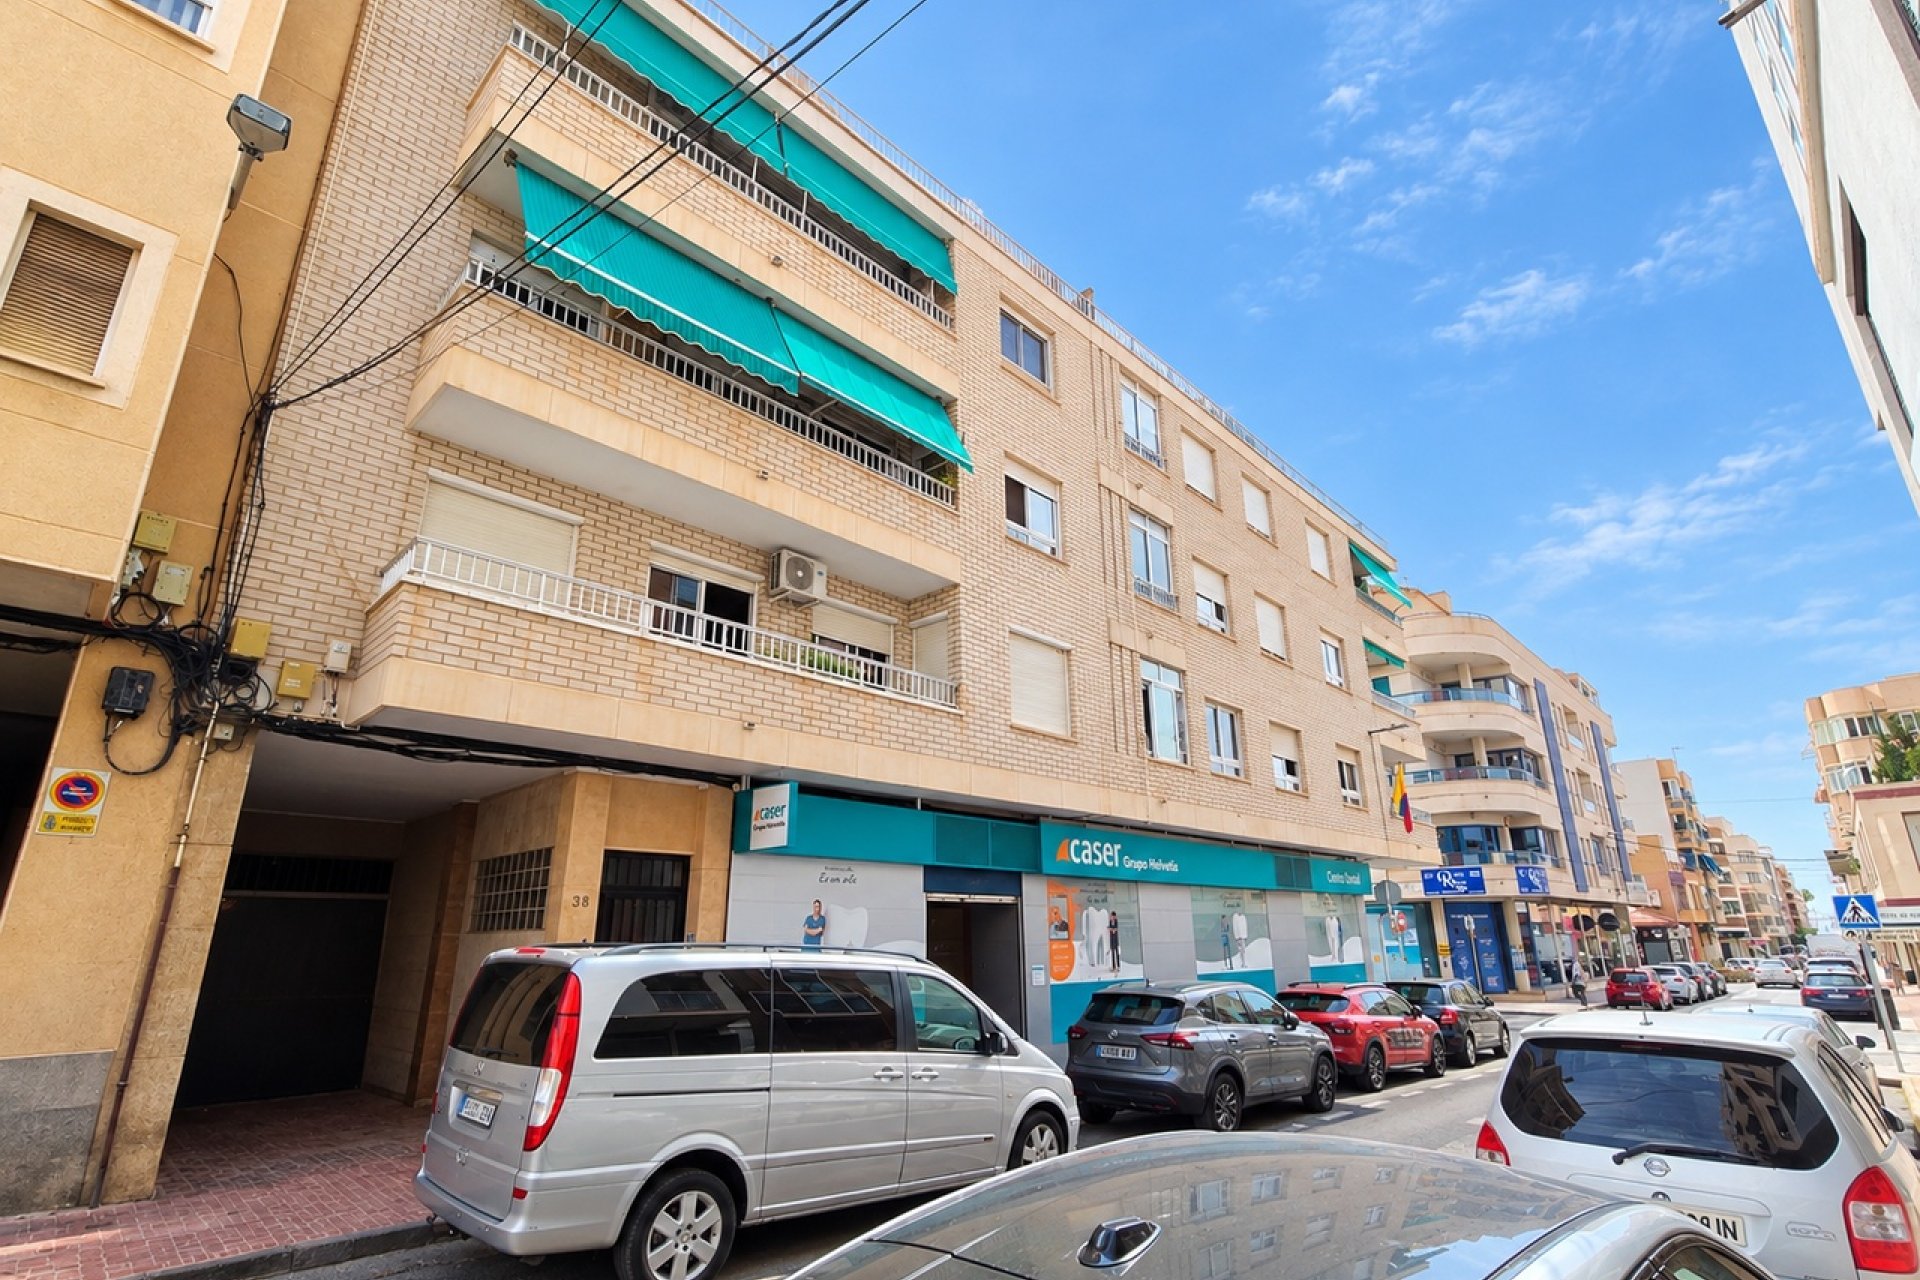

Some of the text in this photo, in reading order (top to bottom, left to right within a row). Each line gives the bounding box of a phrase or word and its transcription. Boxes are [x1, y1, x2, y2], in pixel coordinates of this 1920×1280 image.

[760, 804, 786, 820] caser
[1069, 838, 1121, 867] caser
[1123, 855, 1179, 872] Grupo Helvetia
[572, 894, 589, 908] 38
